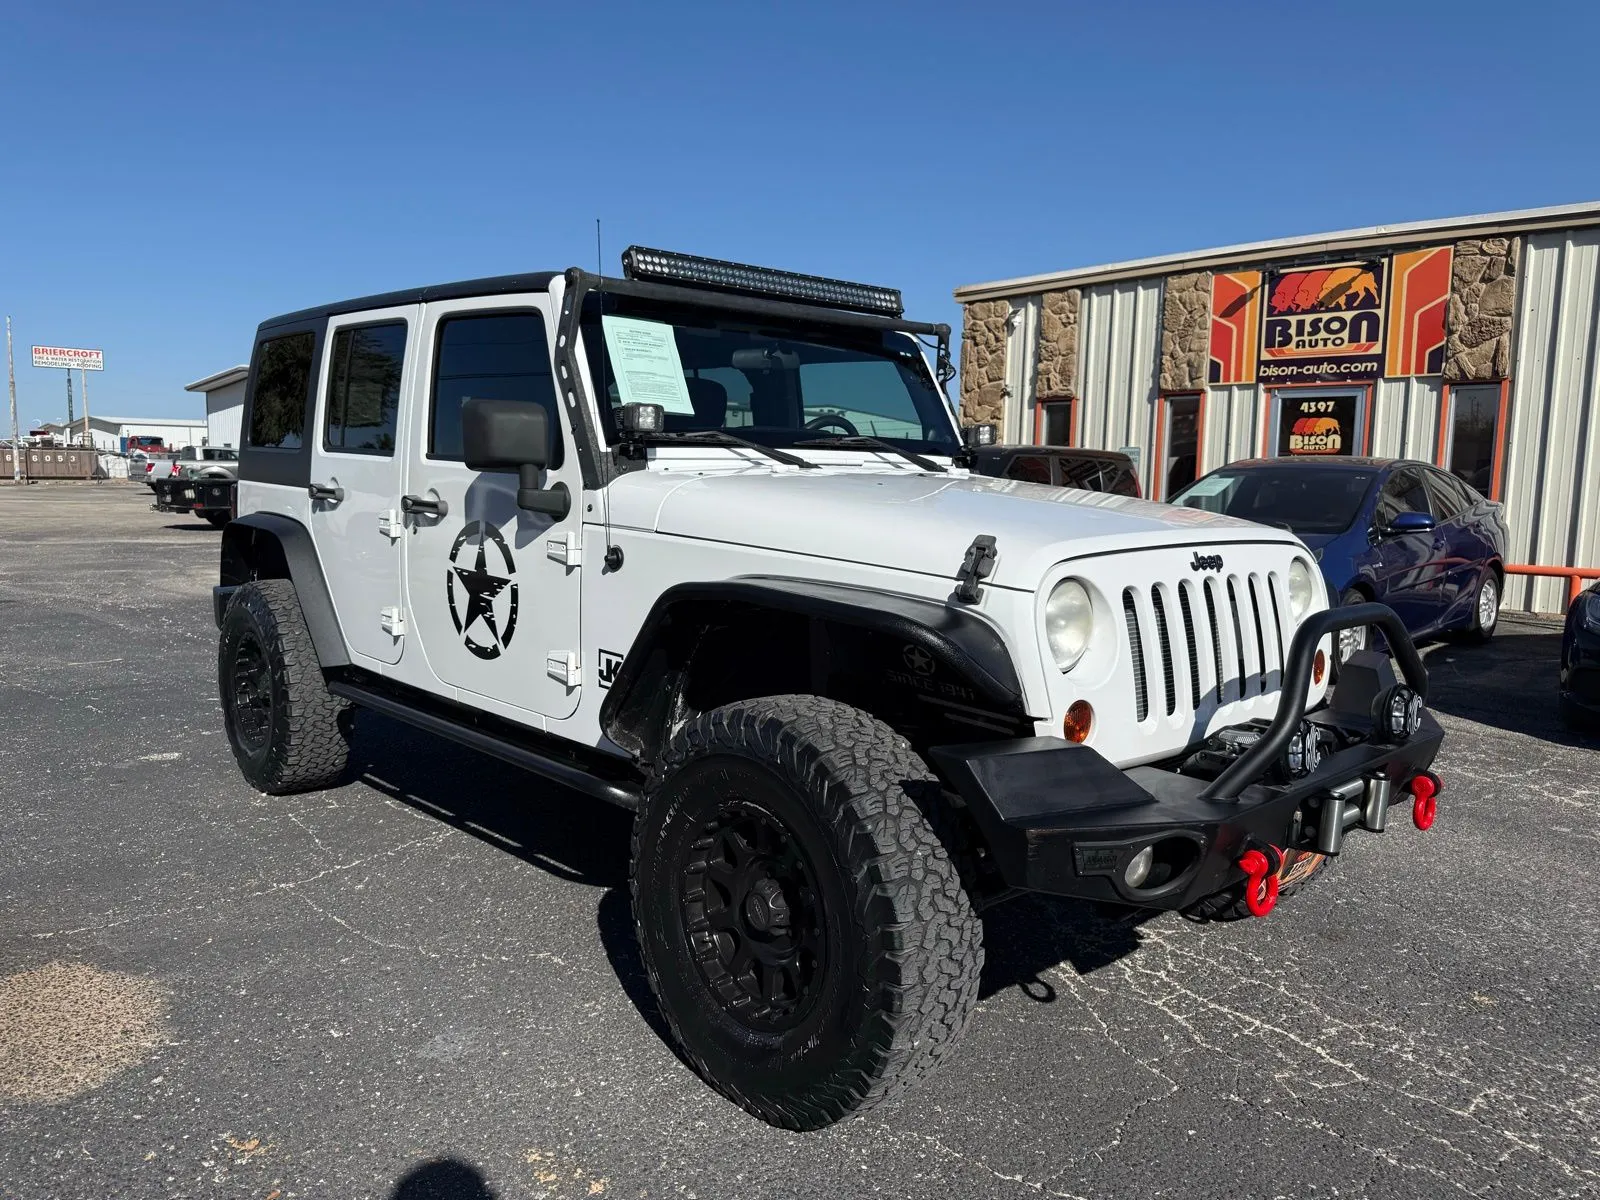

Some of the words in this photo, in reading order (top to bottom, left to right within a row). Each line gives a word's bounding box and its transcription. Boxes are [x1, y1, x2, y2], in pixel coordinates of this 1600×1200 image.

[1265, 310, 1381, 349] BISON
[1295, 336, 1345, 350] AUTO
[34, 348, 101, 358] BRIERCROFT
[1259, 361, 1378, 377] bison-auto.com
[1299, 401, 1336, 413] 4397
[1289, 434, 1342, 449] BISON
[1190, 551, 1224, 573] Jeep
